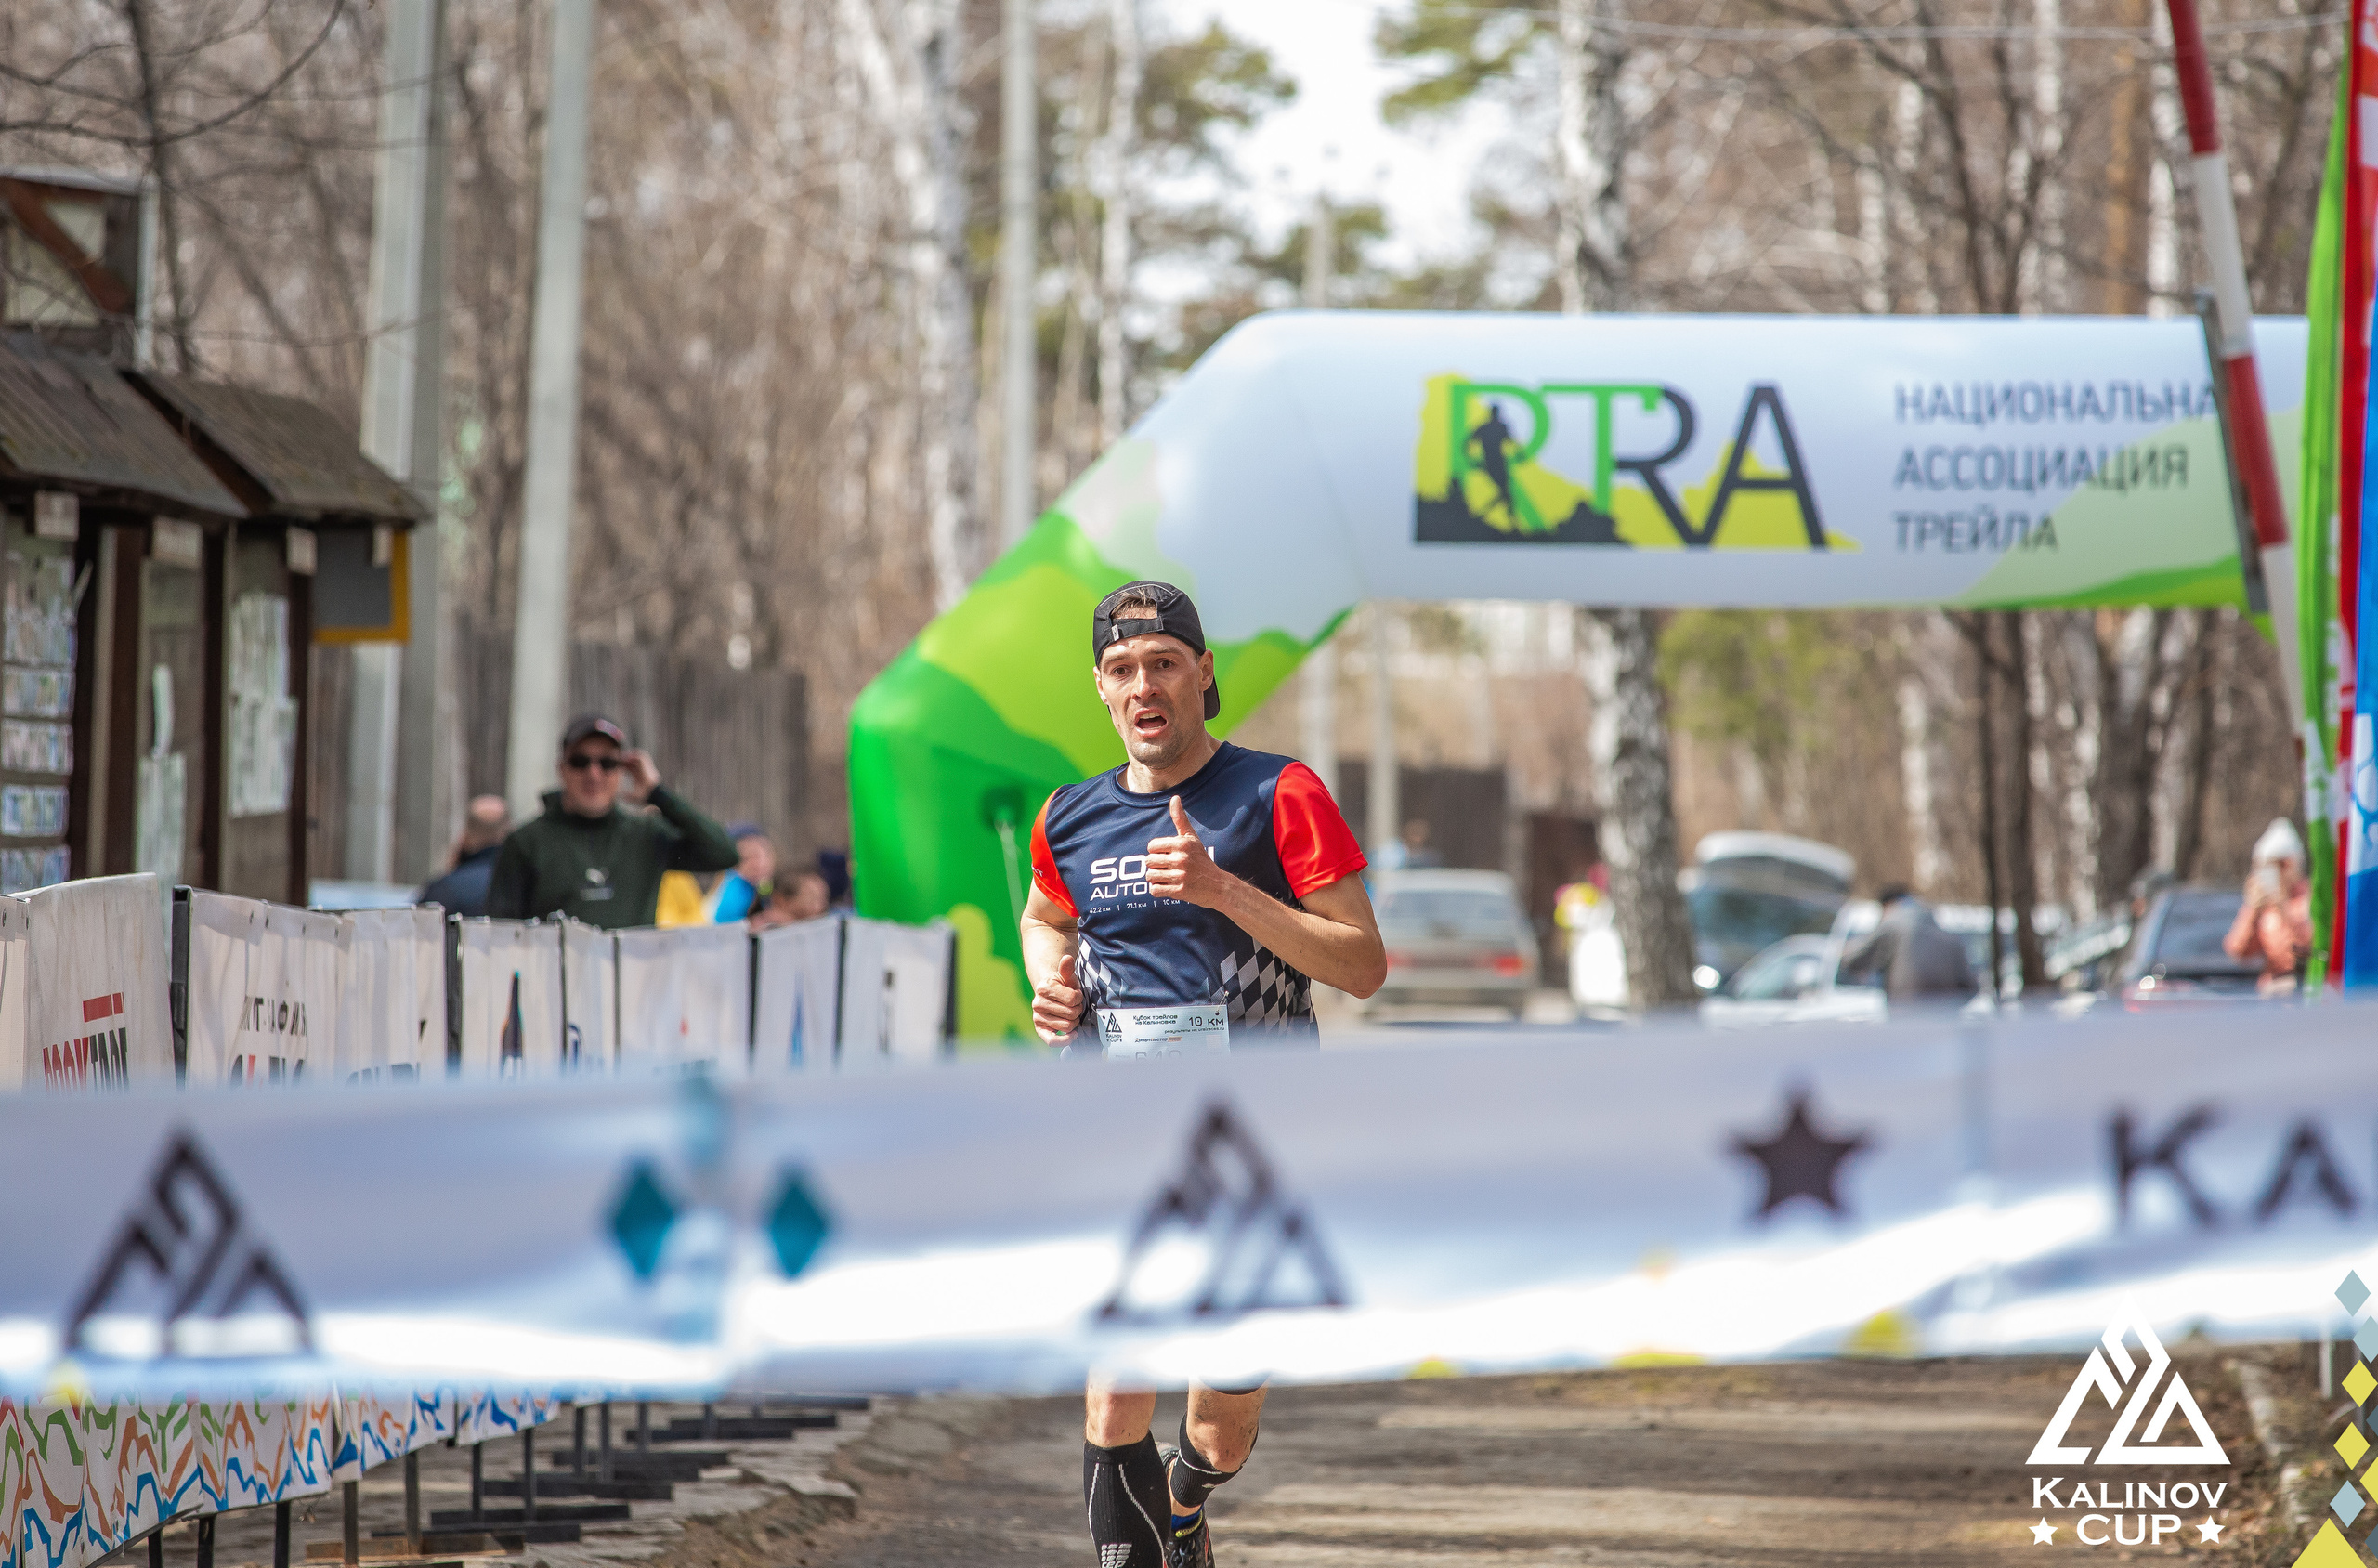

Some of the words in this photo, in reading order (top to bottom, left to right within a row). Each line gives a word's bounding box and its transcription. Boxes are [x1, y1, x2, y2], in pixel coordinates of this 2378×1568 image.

[1893, 381, 2216, 429] НАЦИОНАЛЬНА
[1893, 445, 2189, 497] АССОЦИАЦИЯ
[1896, 504, 2059, 553] ТРЕЙЛА
[1090, 846, 1214, 884] SOI
[1090, 881, 1153, 901] AUTO
[1188, 1016, 1203, 1027] 10
[2107, 1101, 2378, 1224] KA
